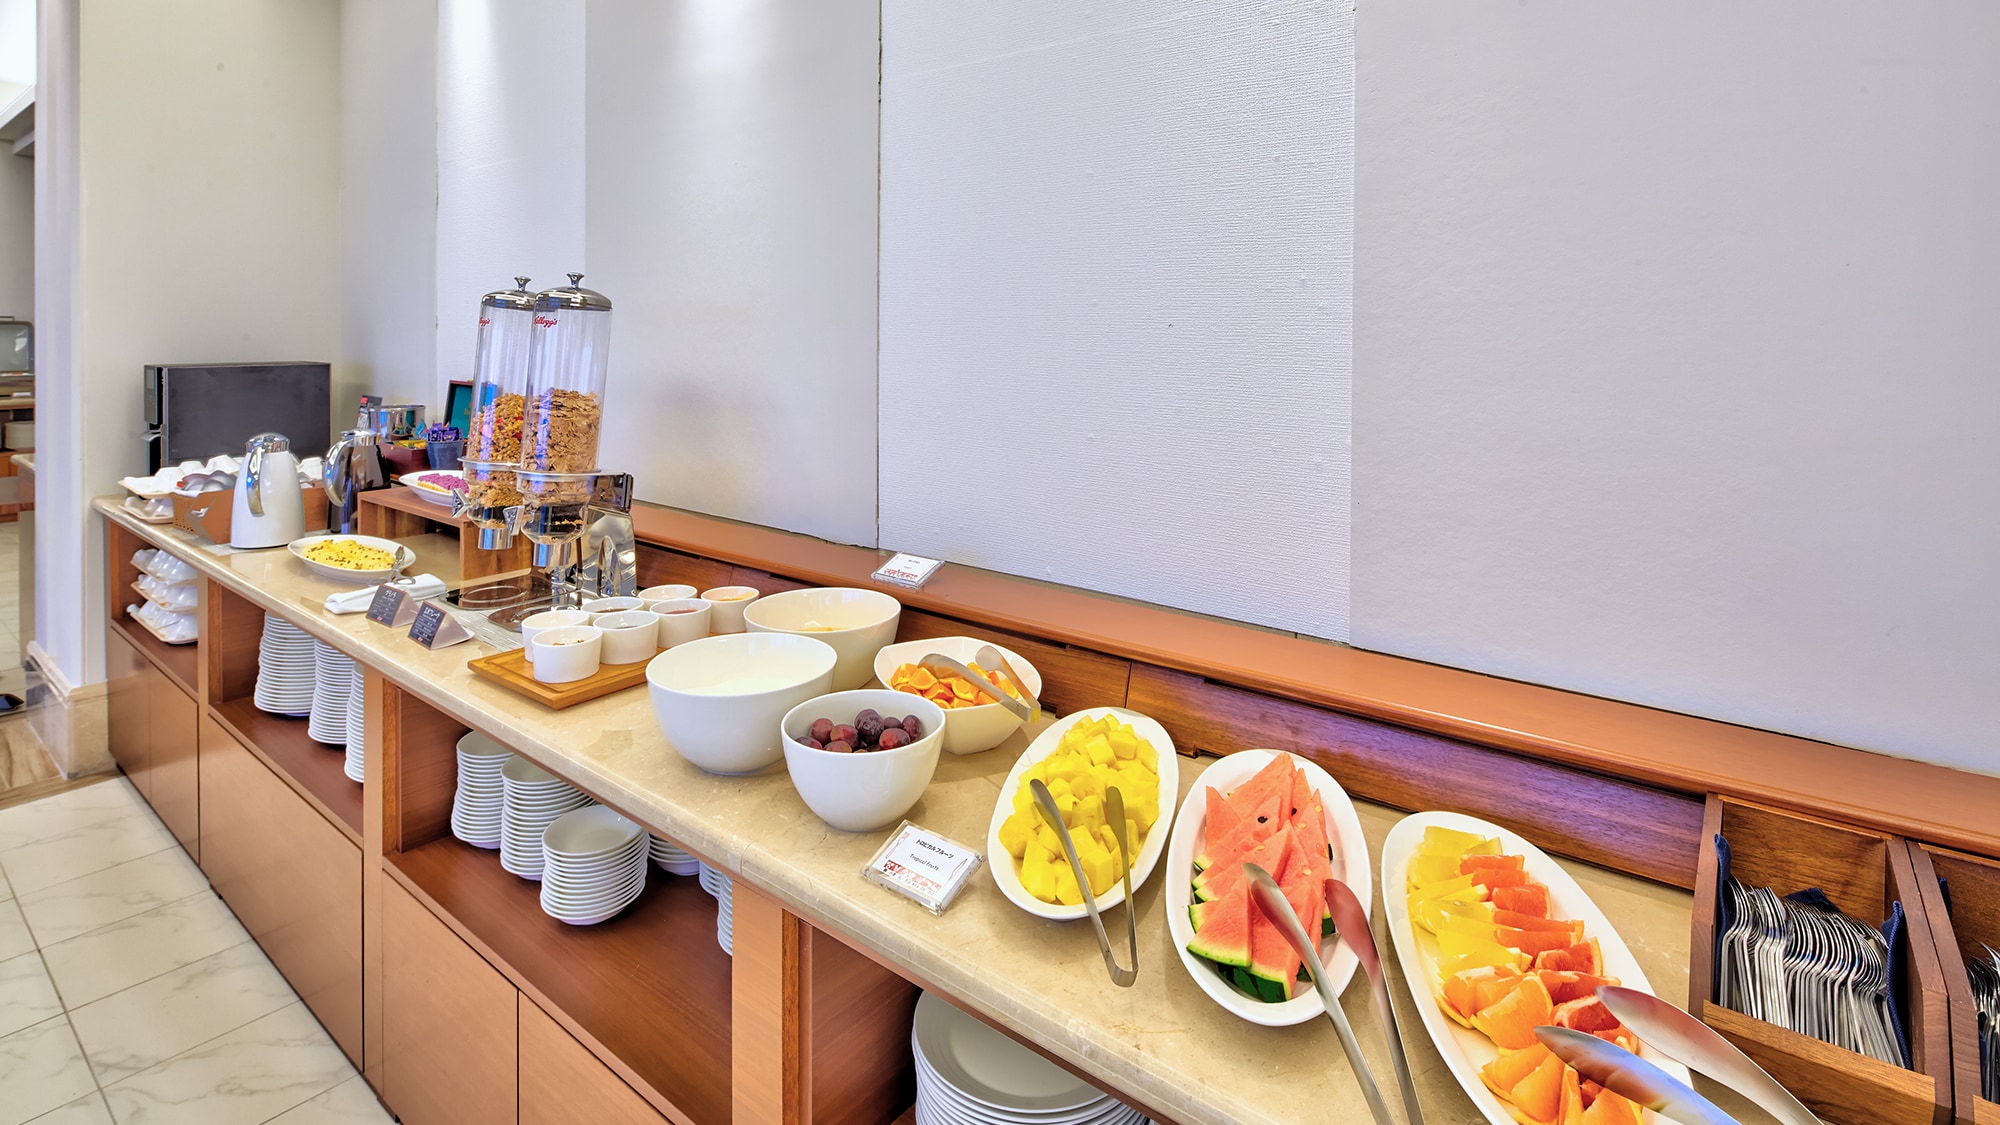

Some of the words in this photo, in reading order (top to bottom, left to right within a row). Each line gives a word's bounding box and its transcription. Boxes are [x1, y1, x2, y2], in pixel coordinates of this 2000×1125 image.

[916, 839, 954, 859] トロピカルフルーツ
[909, 853, 927, 865] Tropical
